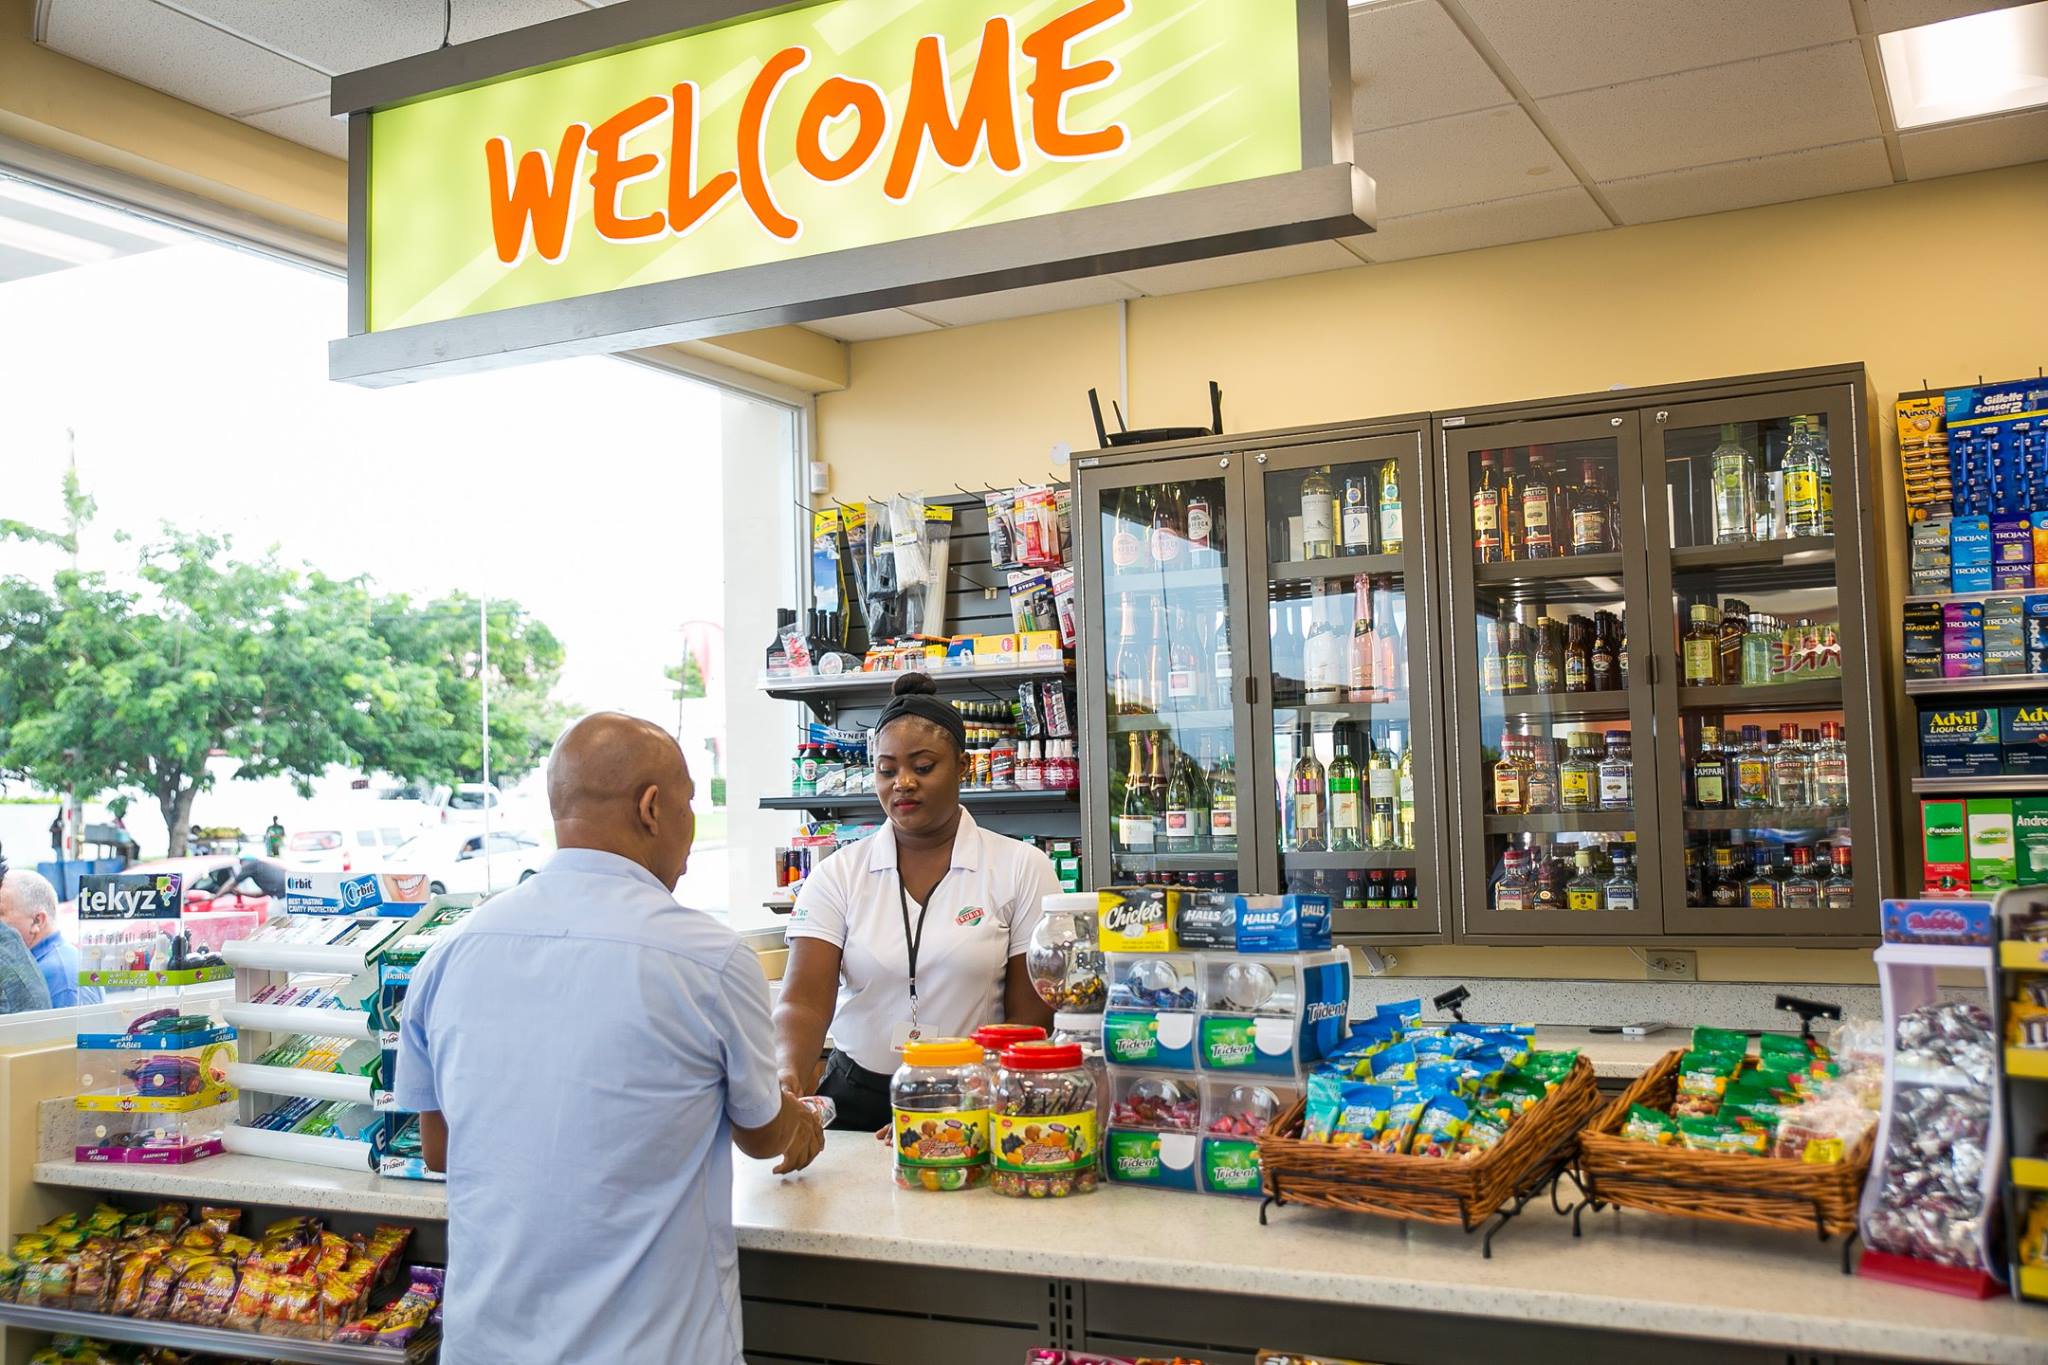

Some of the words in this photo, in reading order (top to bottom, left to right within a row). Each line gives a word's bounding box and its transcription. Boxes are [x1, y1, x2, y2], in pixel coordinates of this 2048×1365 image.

[484, 0, 1128, 265] WELCOME
[1983, 392, 2024, 405] Gillette
[1953, 534, 1988, 543] TROJAN
[1995, 531, 2031, 539] TROJAN
[1913, 537, 1947, 546] TROJAN
[1913, 569, 1948, 578] TROJAN
[1955, 567, 1989, 575] TROJAN
[1996, 564, 2032, 572] TROJAN
[1011, 586, 1017, 594] 4
[1945, 621, 1981, 629] TROJAN
[1986, 617, 2022, 626] TROJAN
[1944, 652, 1981, 660] TROJAN
[1988, 650, 2023, 659] TROJAN
[1930, 711, 1978, 726] Advil
[1694, 767, 1725, 775] CAMPARI
[287, 877, 312, 889] Orbit
[79, 883, 157, 918] tekyz
[1105, 900, 1164, 930] Chiclets
[1184, 909, 1222, 922] HALLS
[1300, 903, 1326, 918] HALLS
[1242, 912, 1281, 926] HALLS
[1307, 1002, 1347, 1025] Trident
[1116, 1038, 1156, 1051] Trident
[1211, 1043, 1254, 1058] Trident
[383, 1159, 407, 1171] Trident
[1118, 1156, 1158, 1170] Trident
[1214, 1167, 1256, 1181] Trident
